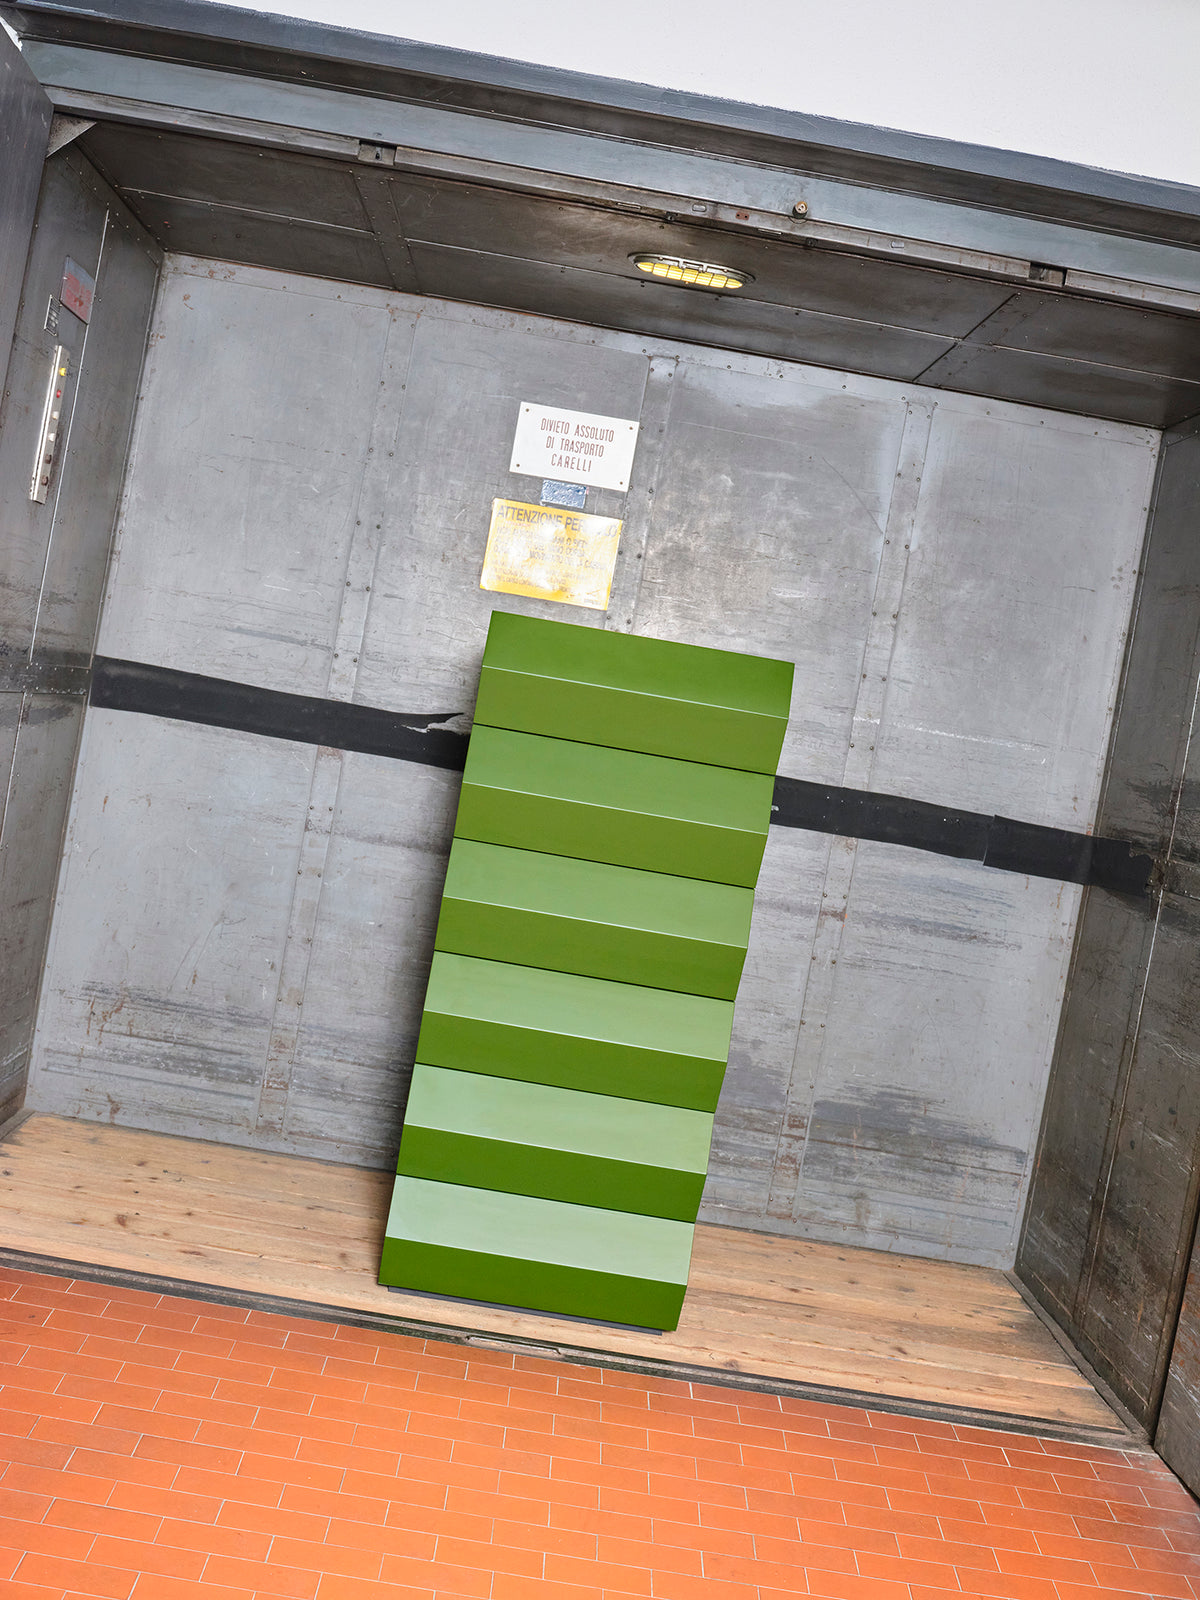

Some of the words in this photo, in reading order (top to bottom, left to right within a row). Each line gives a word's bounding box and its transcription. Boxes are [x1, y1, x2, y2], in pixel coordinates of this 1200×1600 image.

[541, 418, 570, 435] DIVIETO
[574, 424, 615, 442] ASSOLUTO
[546, 436, 555, 449] DI
[560, 438, 605, 457] TRASPORTO
[551, 453, 592, 472] CARELLI
